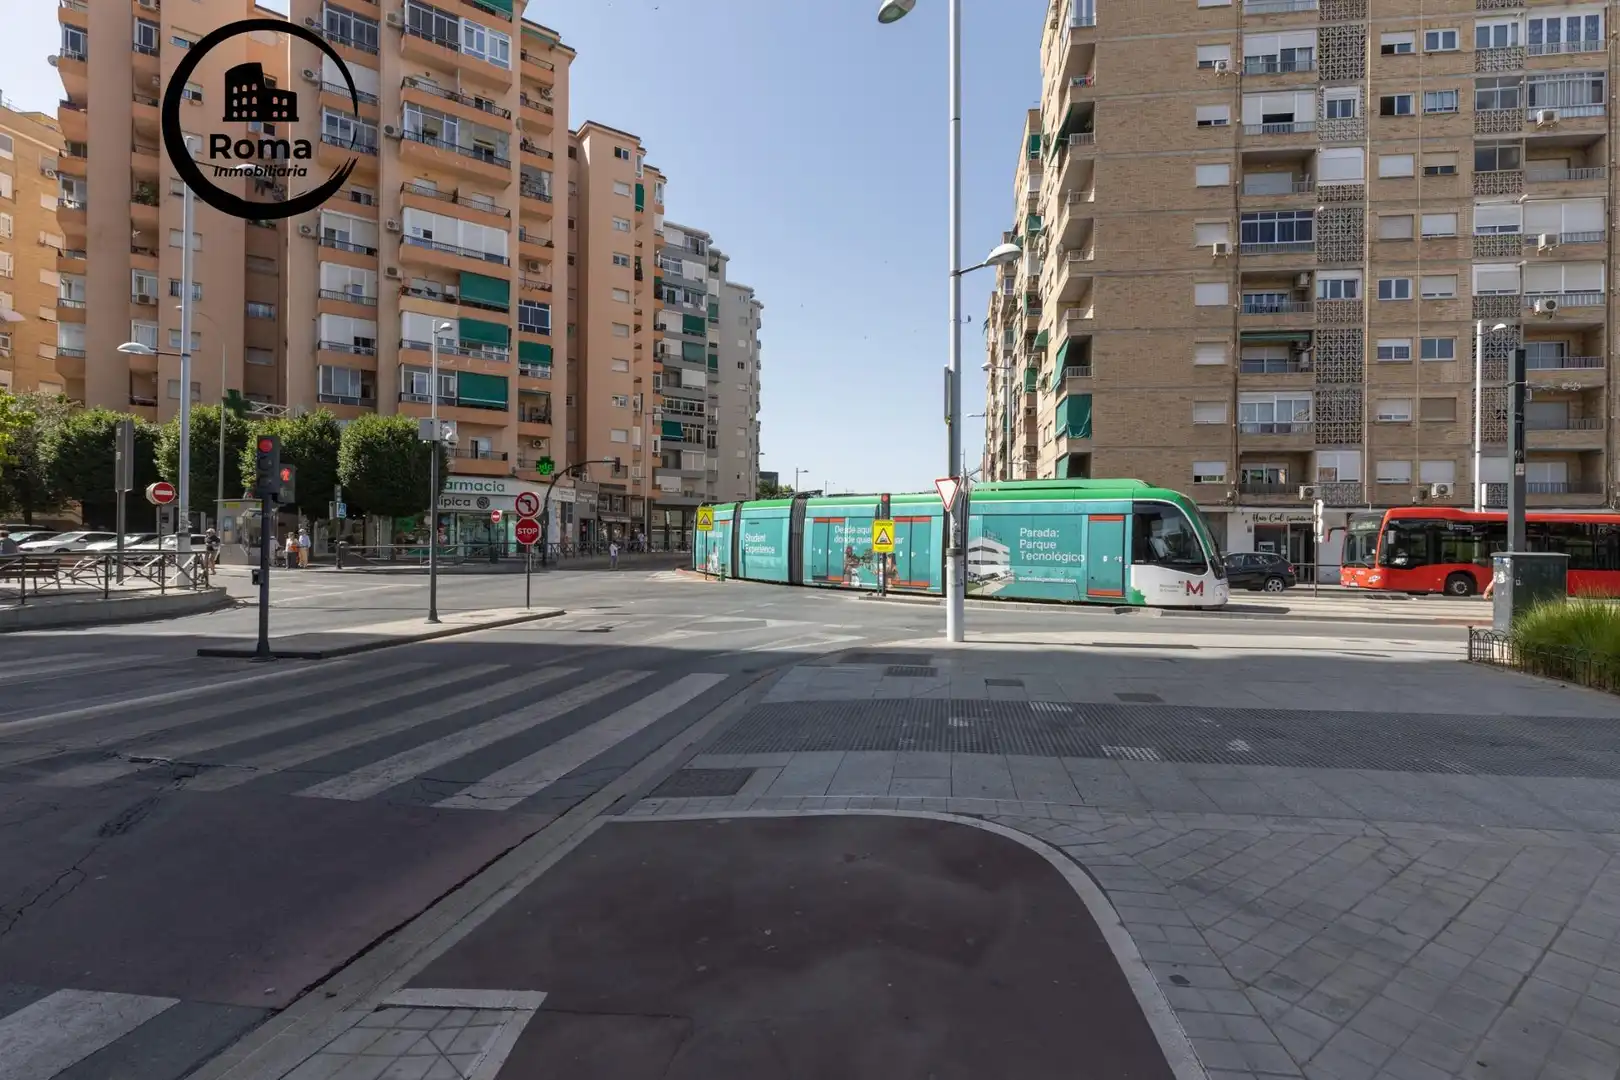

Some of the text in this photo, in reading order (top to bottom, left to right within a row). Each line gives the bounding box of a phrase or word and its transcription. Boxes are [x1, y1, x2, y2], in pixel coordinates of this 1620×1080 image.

[445, 481, 505, 492] armacia
[517, 527, 538, 535] STOP
[834, 525, 856, 534] Desde
[1020, 527, 1060, 538] Parada:
[745, 532, 767, 543] Student
[834, 535, 855, 544] donde
[745, 543, 776, 555] Experience
[1019, 539, 1057, 551] Parque
[1020, 550, 1085, 564] Tecnológico
[1186, 579, 1204, 597] M
